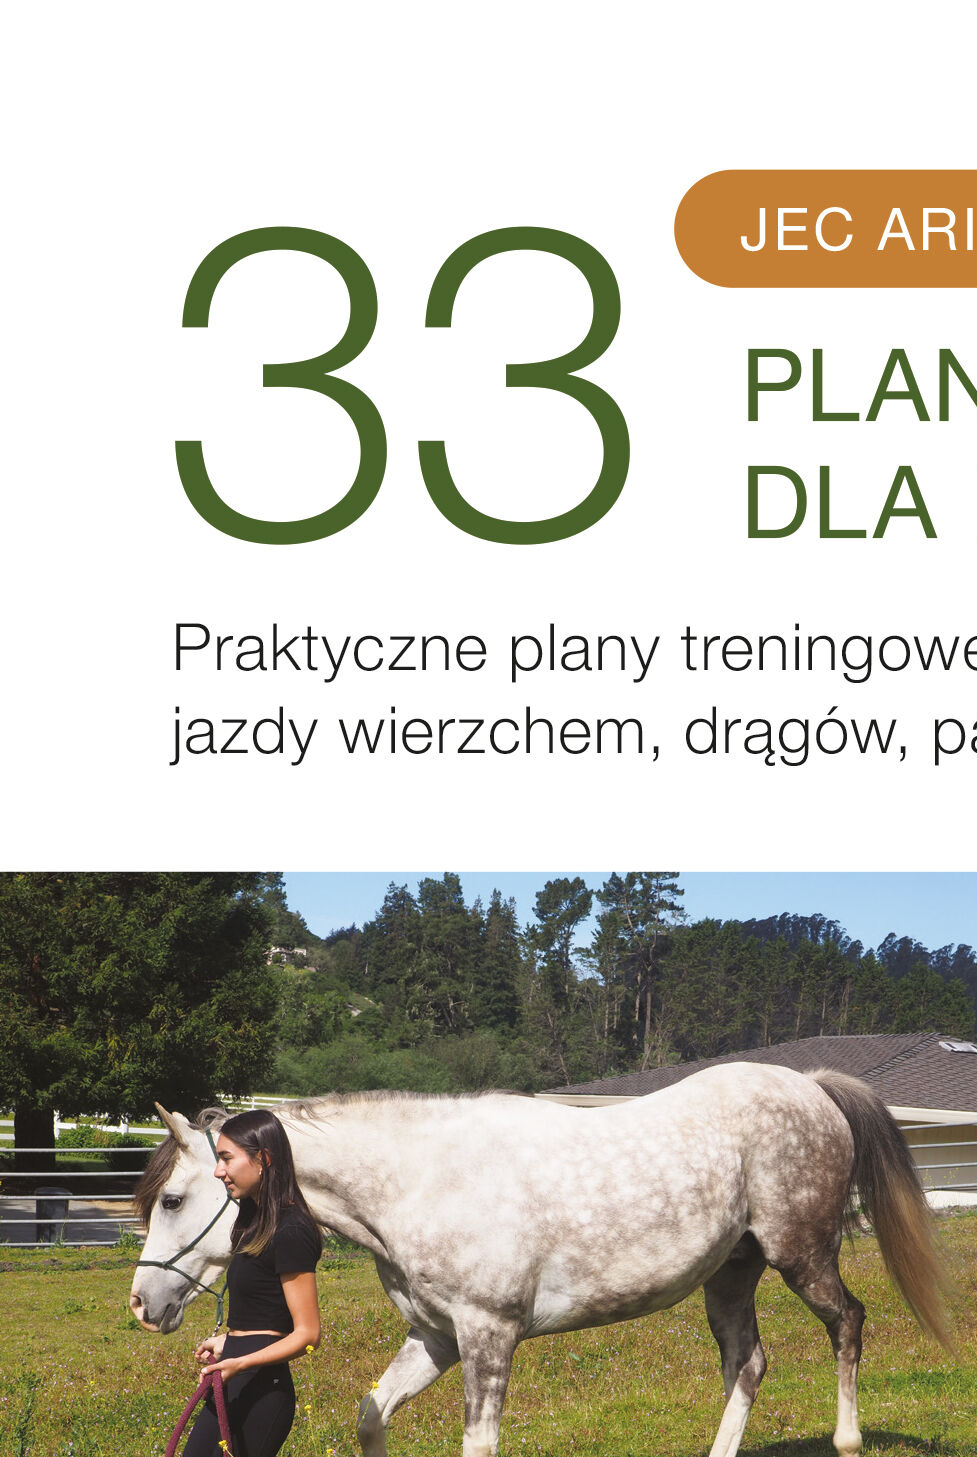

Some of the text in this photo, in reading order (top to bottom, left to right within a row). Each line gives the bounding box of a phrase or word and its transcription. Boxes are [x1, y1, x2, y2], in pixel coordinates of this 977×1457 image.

[741, 207, 852, 251] JEC
[175, 226, 630, 545] 33
[748, 466, 937, 538] DLA
[176, 623, 486, 683] Praktyczne
[512, 623, 660, 683] plany
[170, 707, 317, 766] jazdy
[339, 706, 659, 761] wierzchem,
[686, 706, 906, 766] drągów,
